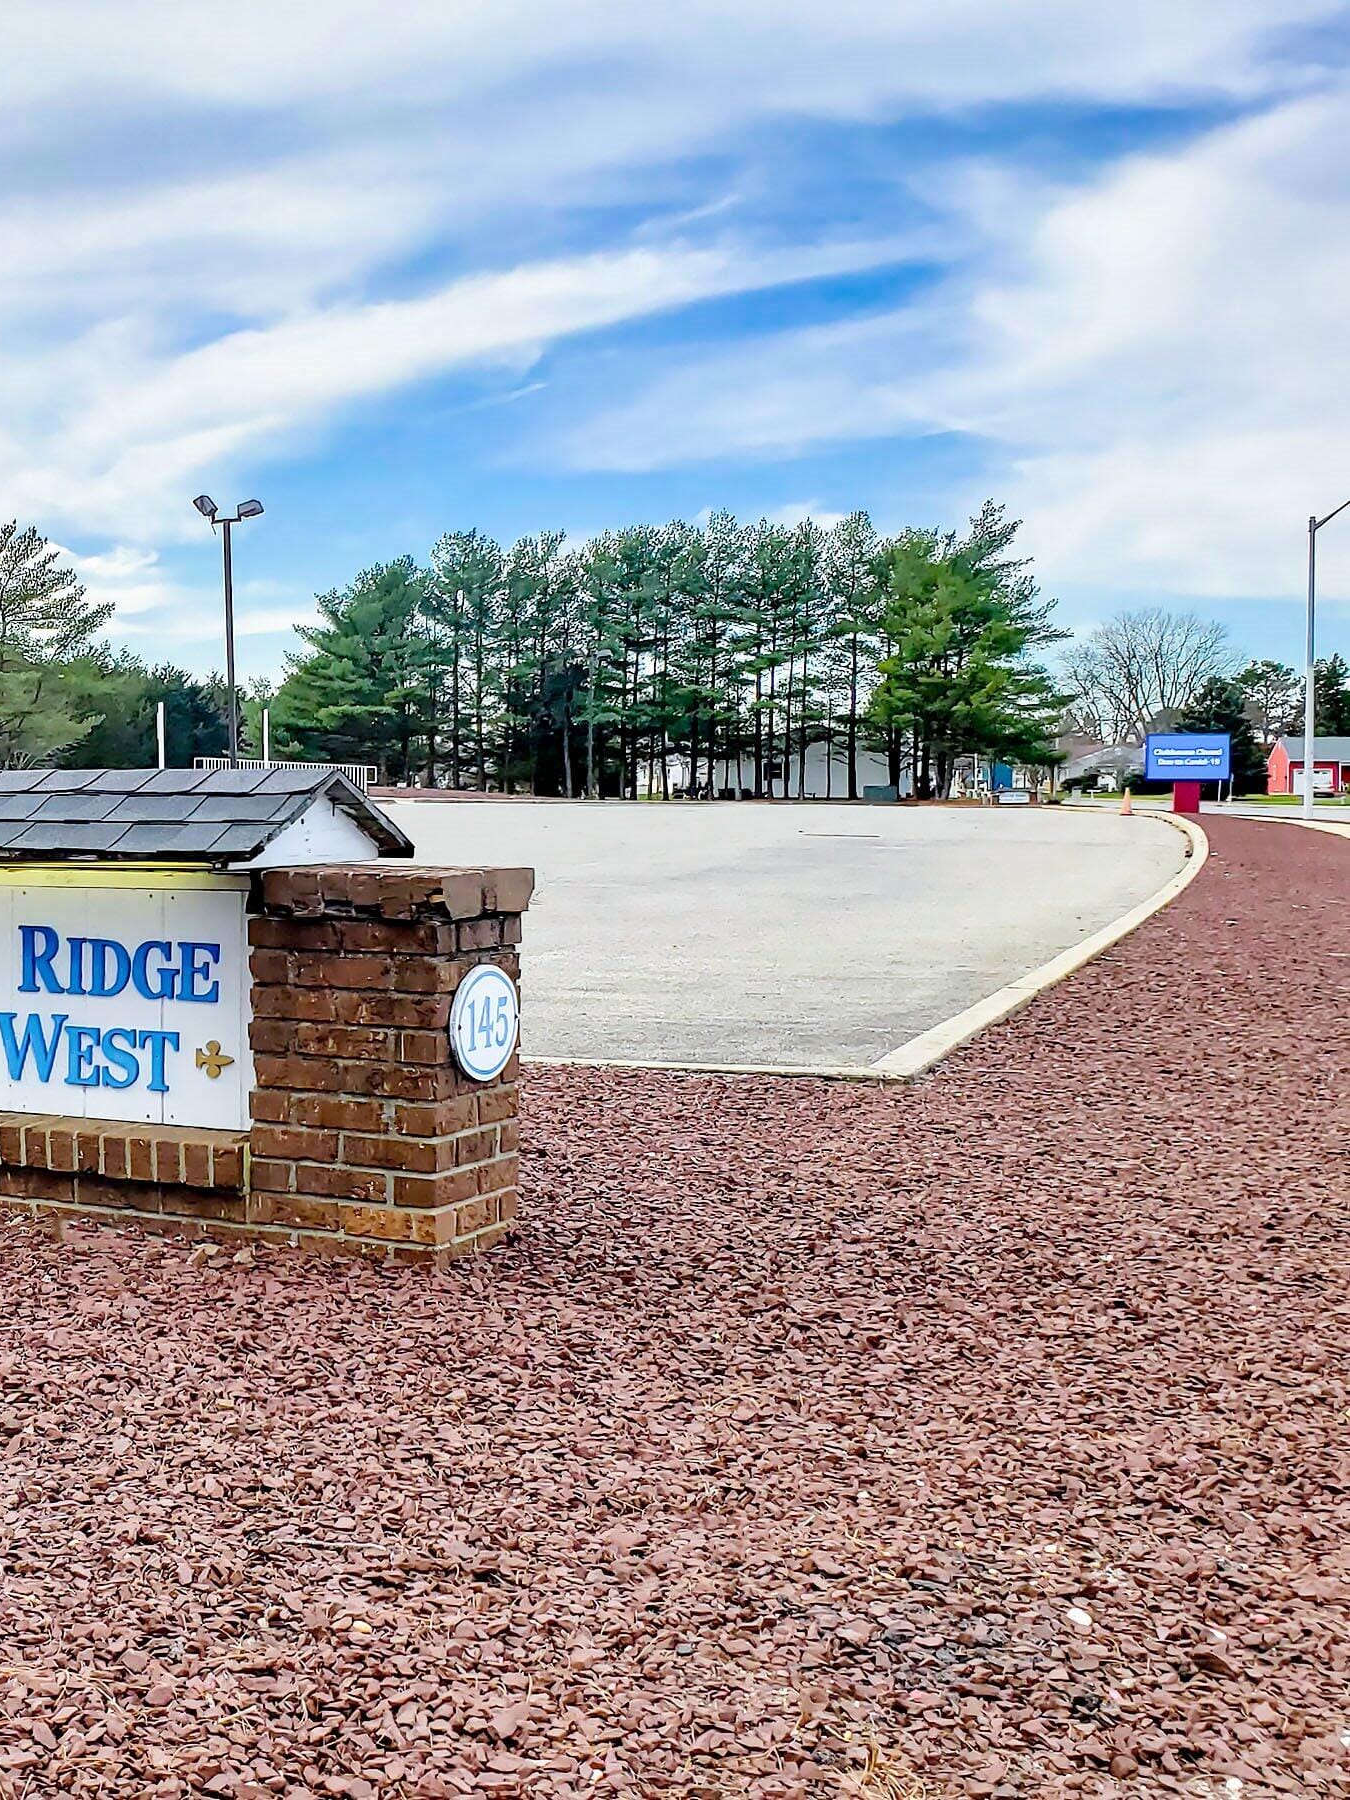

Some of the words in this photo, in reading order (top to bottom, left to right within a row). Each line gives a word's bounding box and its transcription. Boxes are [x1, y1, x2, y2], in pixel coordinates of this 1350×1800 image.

[1185, 758, 1220, 766] Cd-19
[17, 924, 221, 1004] RIDGE
[467, 996, 509, 1052] 145
